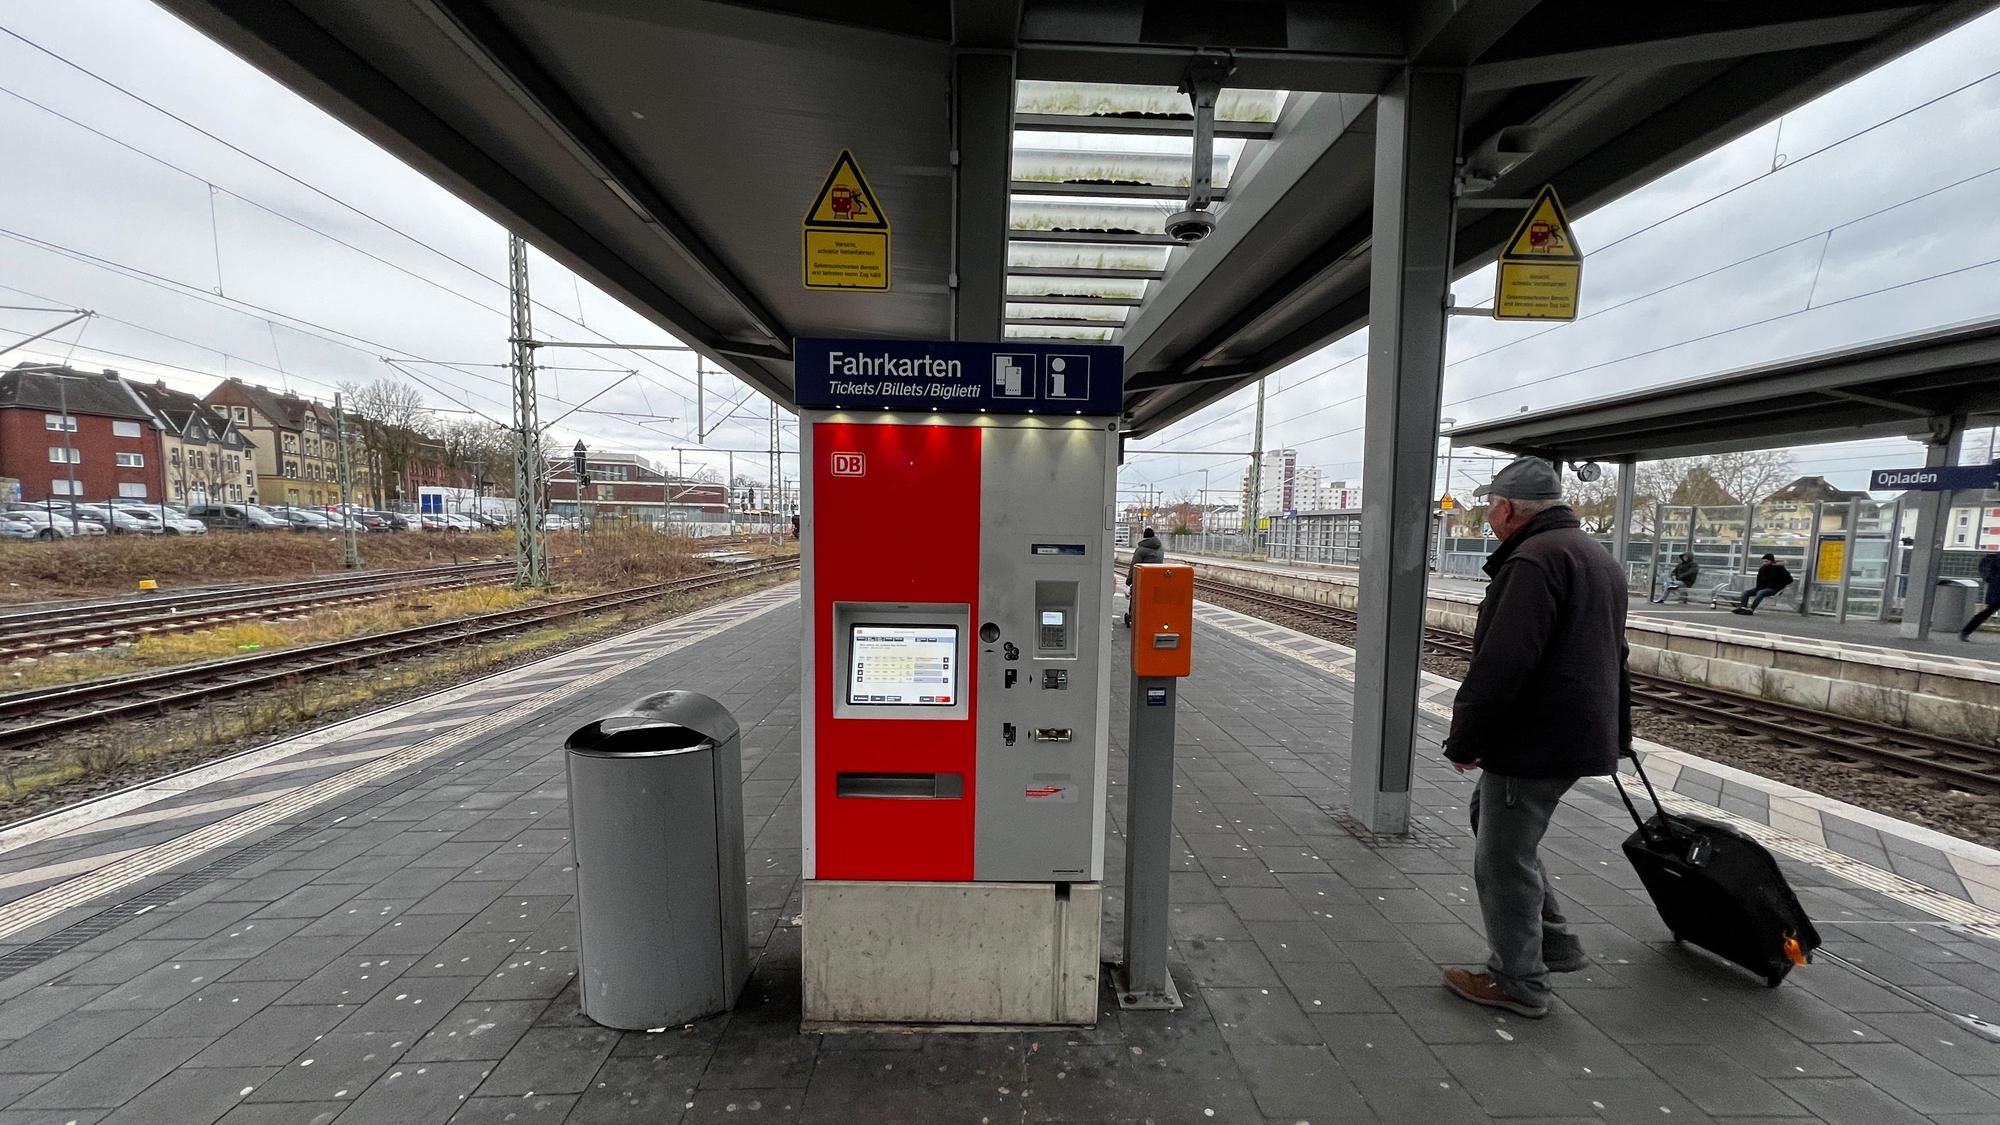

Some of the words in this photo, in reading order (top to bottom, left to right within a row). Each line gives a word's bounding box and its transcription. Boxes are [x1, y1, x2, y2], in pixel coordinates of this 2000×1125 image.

[829, 351, 961, 378] Fahrkarten
[836, 456, 861, 473] DB
[1878, 471, 1938, 487] Opladen
